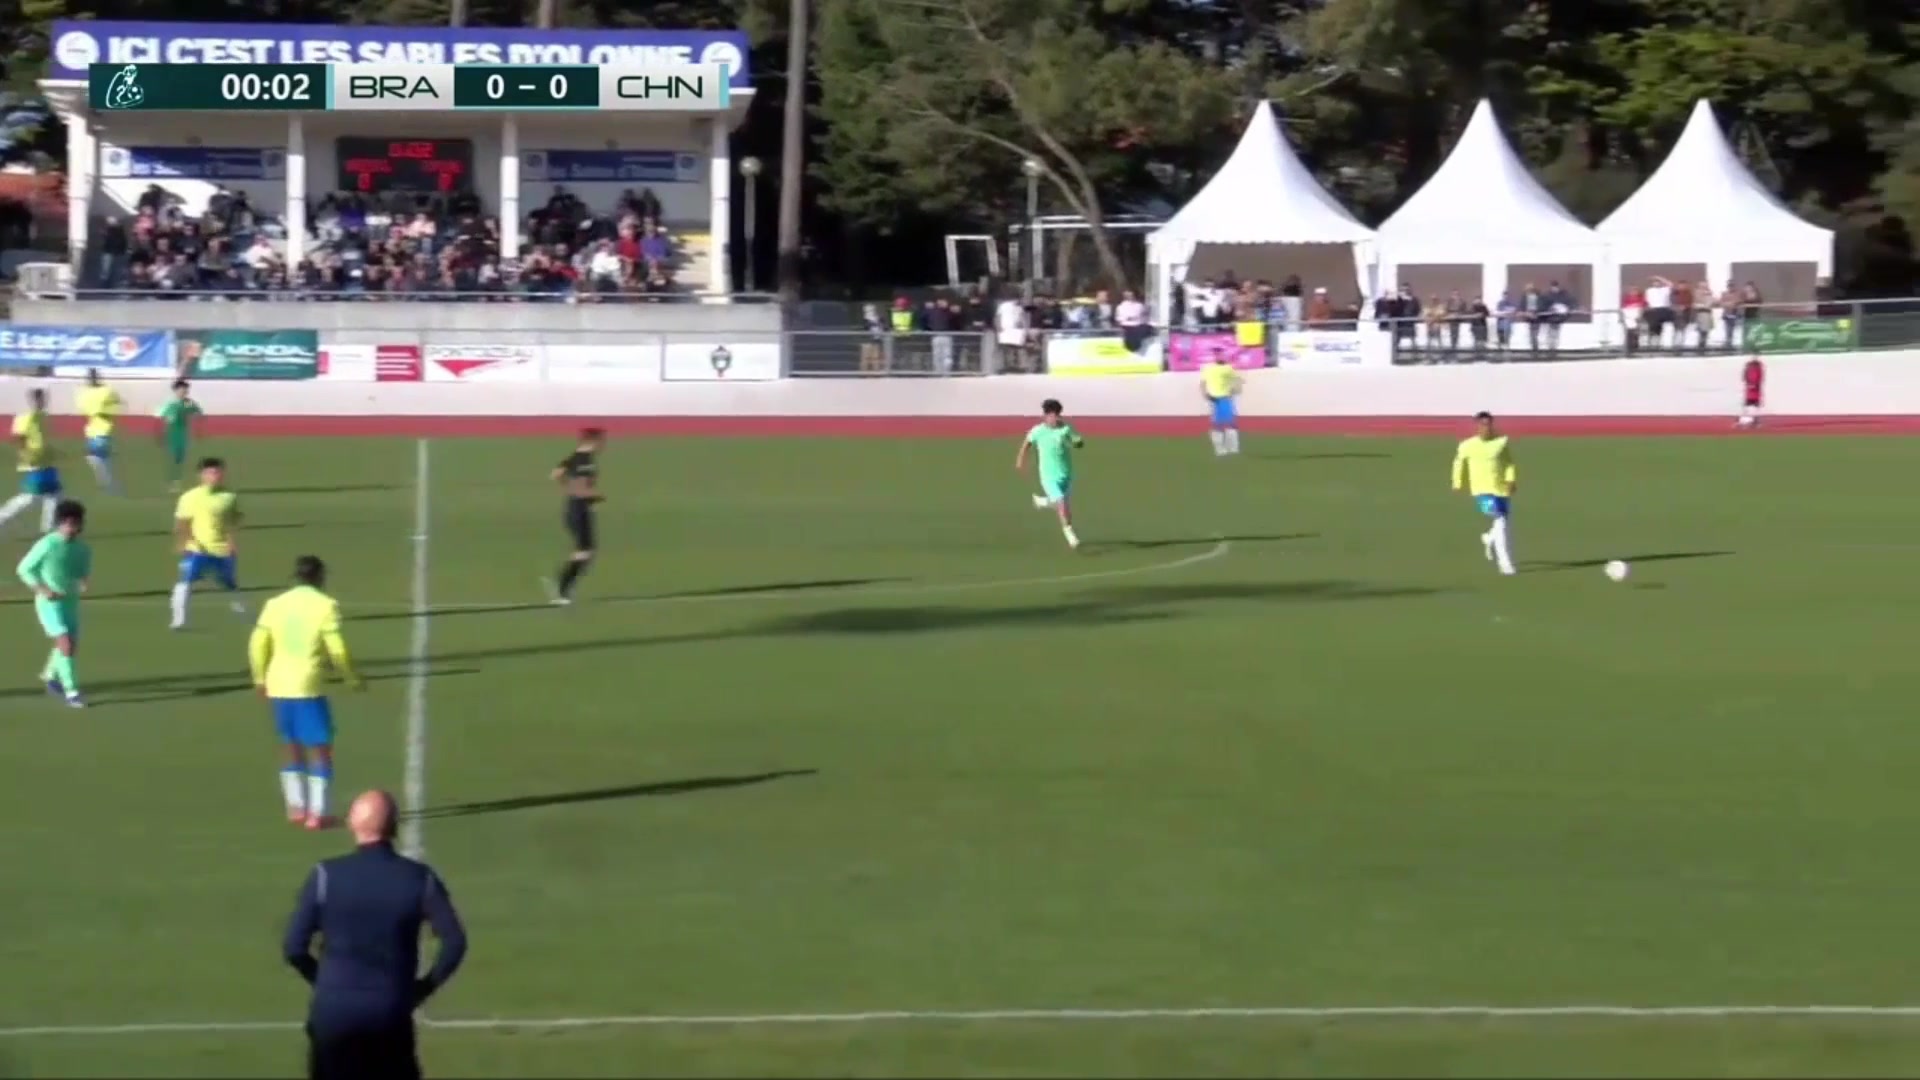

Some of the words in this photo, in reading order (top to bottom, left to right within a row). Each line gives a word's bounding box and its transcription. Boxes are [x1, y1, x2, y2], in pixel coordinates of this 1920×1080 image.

[108, 36, 160, 63] ICI
[166, 38, 275, 63] C'EST
[280, 39, 352, 63] LES
